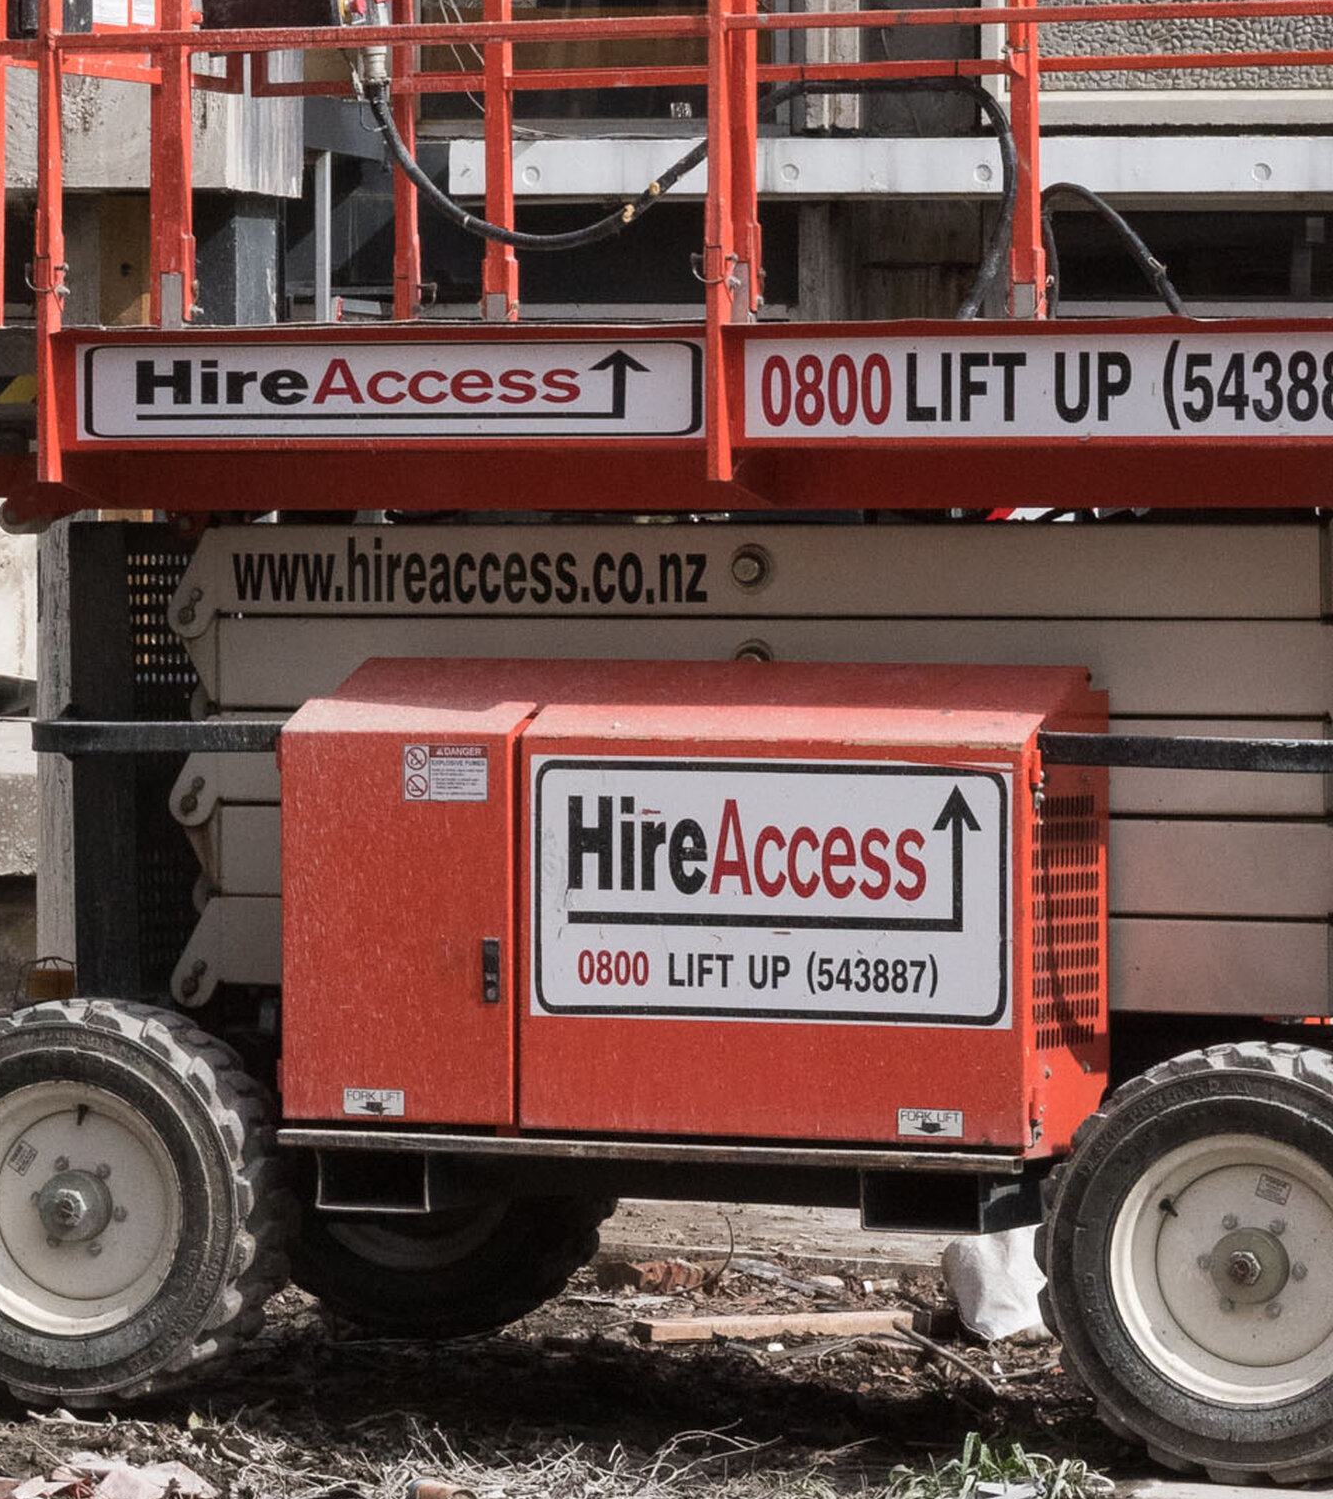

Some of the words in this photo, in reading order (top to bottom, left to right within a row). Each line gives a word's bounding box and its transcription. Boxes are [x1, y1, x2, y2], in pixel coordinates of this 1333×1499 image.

[136, 358, 581, 405] HireAccess
[761, 352, 892, 427] 0800
[905, 352, 1027, 423] LIFT
[1053, 351, 1133, 422] UP
[232, 537, 707, 605] www.hireaccess.co.nz
[444, 747, 482, 756] DANGER
[568, 795, 927, 900] HireAccess
[578, 949, 650, 987] 0800
[668, 953, 732, 988] LIFT
[748, 955, 790, 990] UP
[806, 950, 939, 998] (543887)
[346, 1090, 376, 1101] FORK
[380, 1092, 401, 1103] LIFT
[900, 1110, 932, 1122] FORK
[937, 1113, 959, 1123] LIFT
